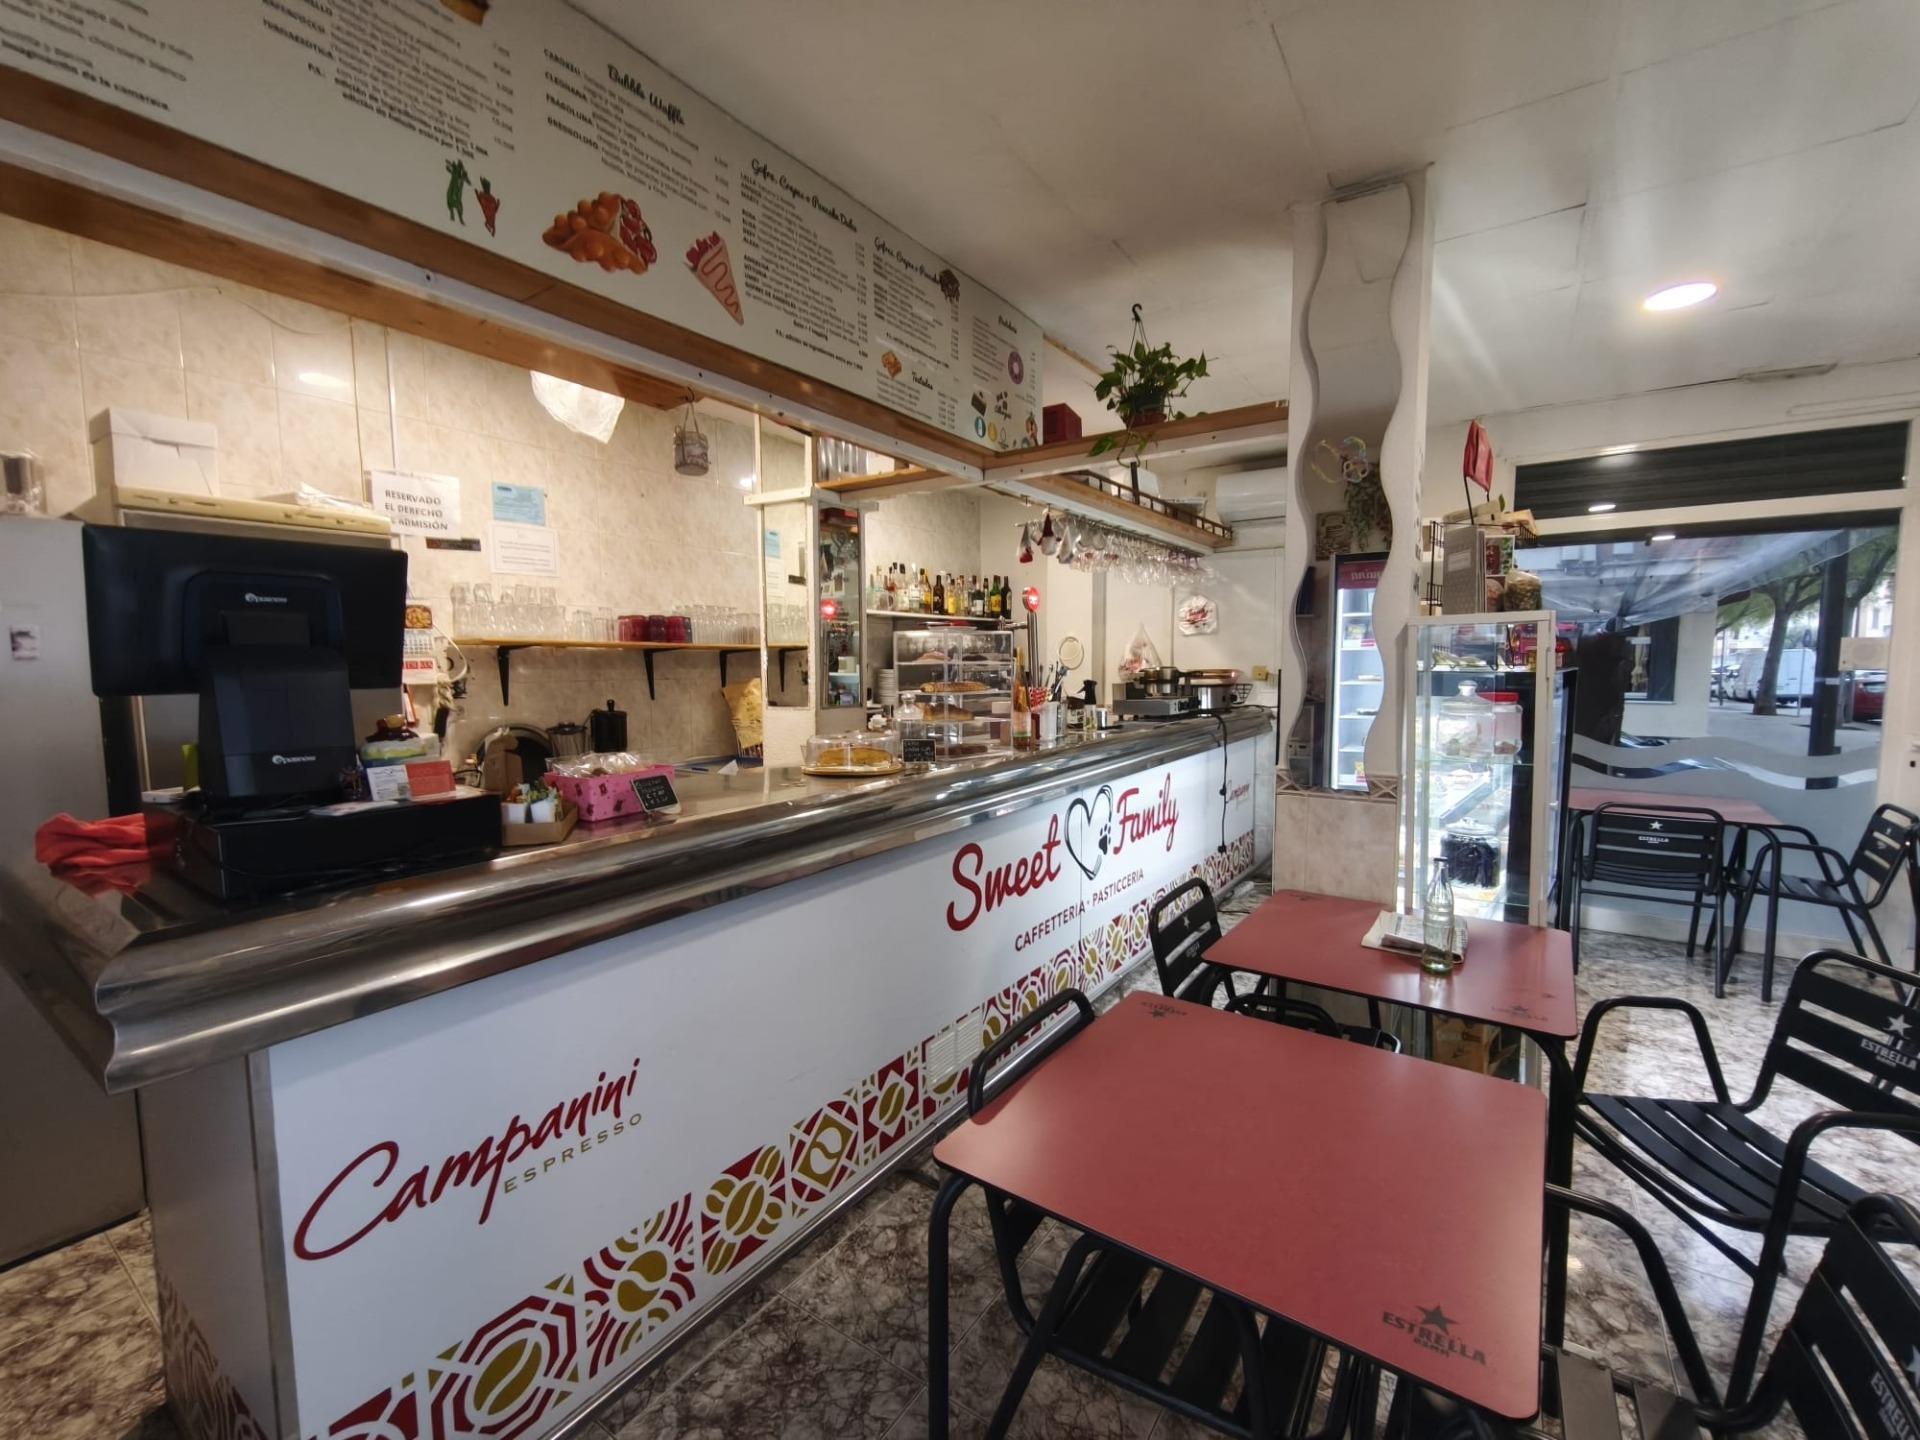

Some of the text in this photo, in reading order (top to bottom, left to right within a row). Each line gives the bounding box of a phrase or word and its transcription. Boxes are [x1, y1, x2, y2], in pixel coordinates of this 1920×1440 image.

[384, 489, 442, 506] RESERVADO
[384, 502, 444, 518] EL DERECHO
[946, 772, 1180, 932] Sweet Family
[1014, 867, 1145, 953] CAFFETTERIA PASTICCERIA
[1860, 1037, 1918, 1071] ESTRELLA
[293, 1057, 641, 1261] Campanini
[503, 1112, 643, 1195] ESPRESSO
[1381, 1309, 1487, 1366] ESTRELLA
